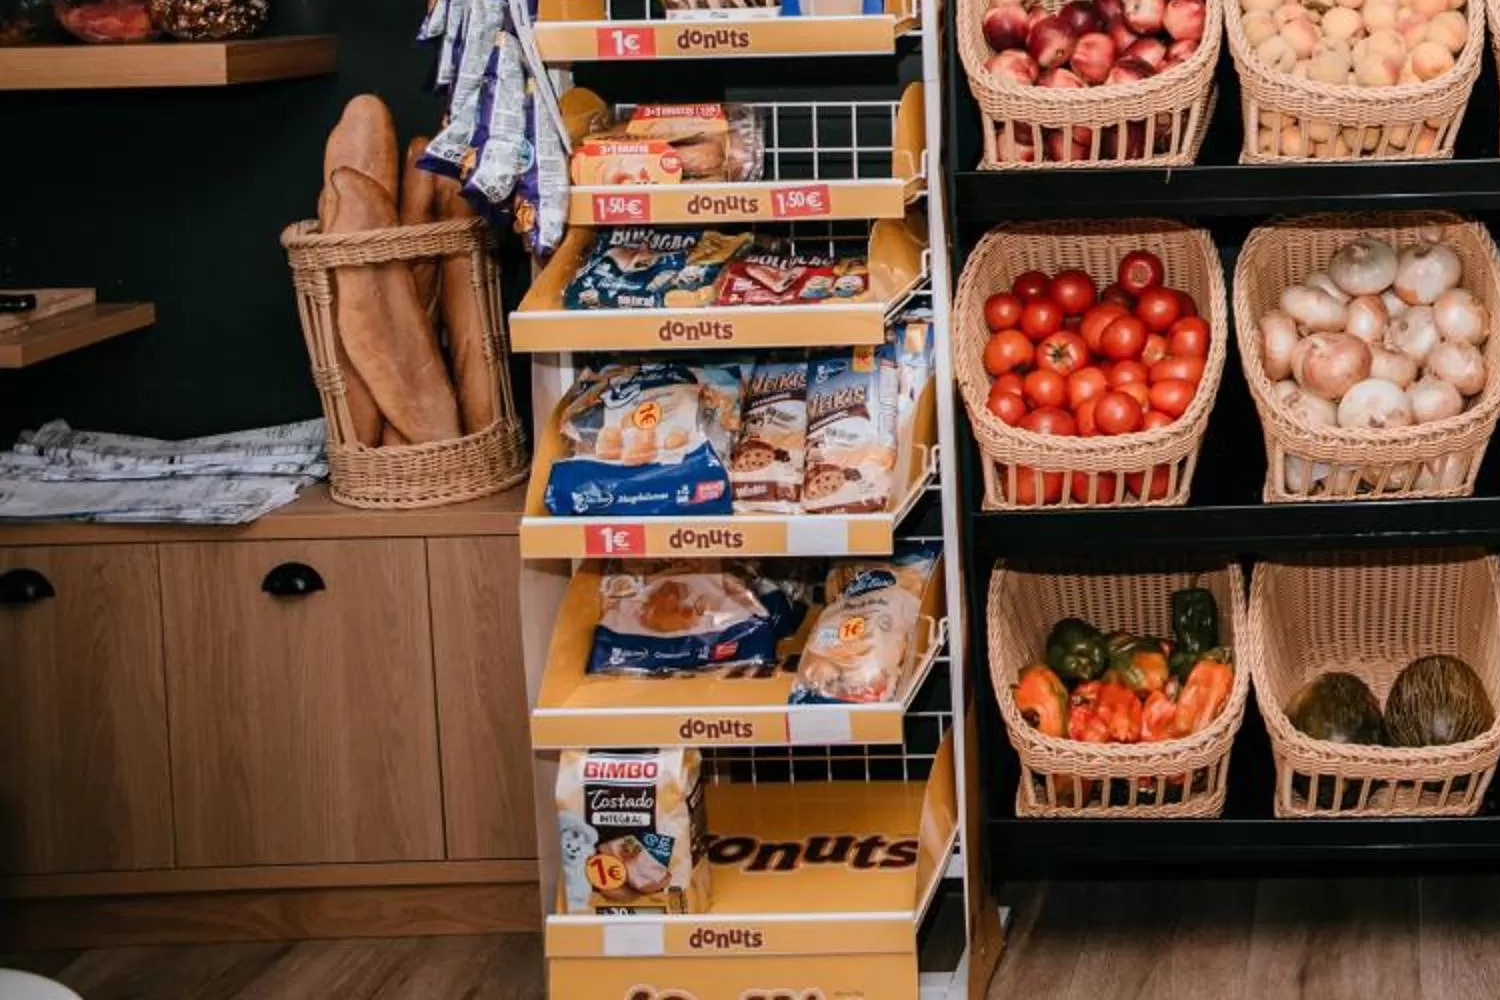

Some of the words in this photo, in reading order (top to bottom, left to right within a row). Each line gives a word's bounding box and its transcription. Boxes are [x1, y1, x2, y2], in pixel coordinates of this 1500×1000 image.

[611, 30, 640, 54] 1€
[677, 29, 749, 50] donuts
[687, 194, 758, 215] donuts
[659, 320, 733, 342] donuts
[600, 527, 629, 552] 1€
[669, 527, 744, 549] donuts
[679, 719, 753, 739] donuts
[583, 761, 658, 779] BIMBO
[587, 789, 654, 811] Tostado
[598, 814, 644, 825] INTEGRAL
[703, 834, 918, 872] onuts
[589, 857, 622, 886] 1€
[690, 927, 763, 949] donuts
